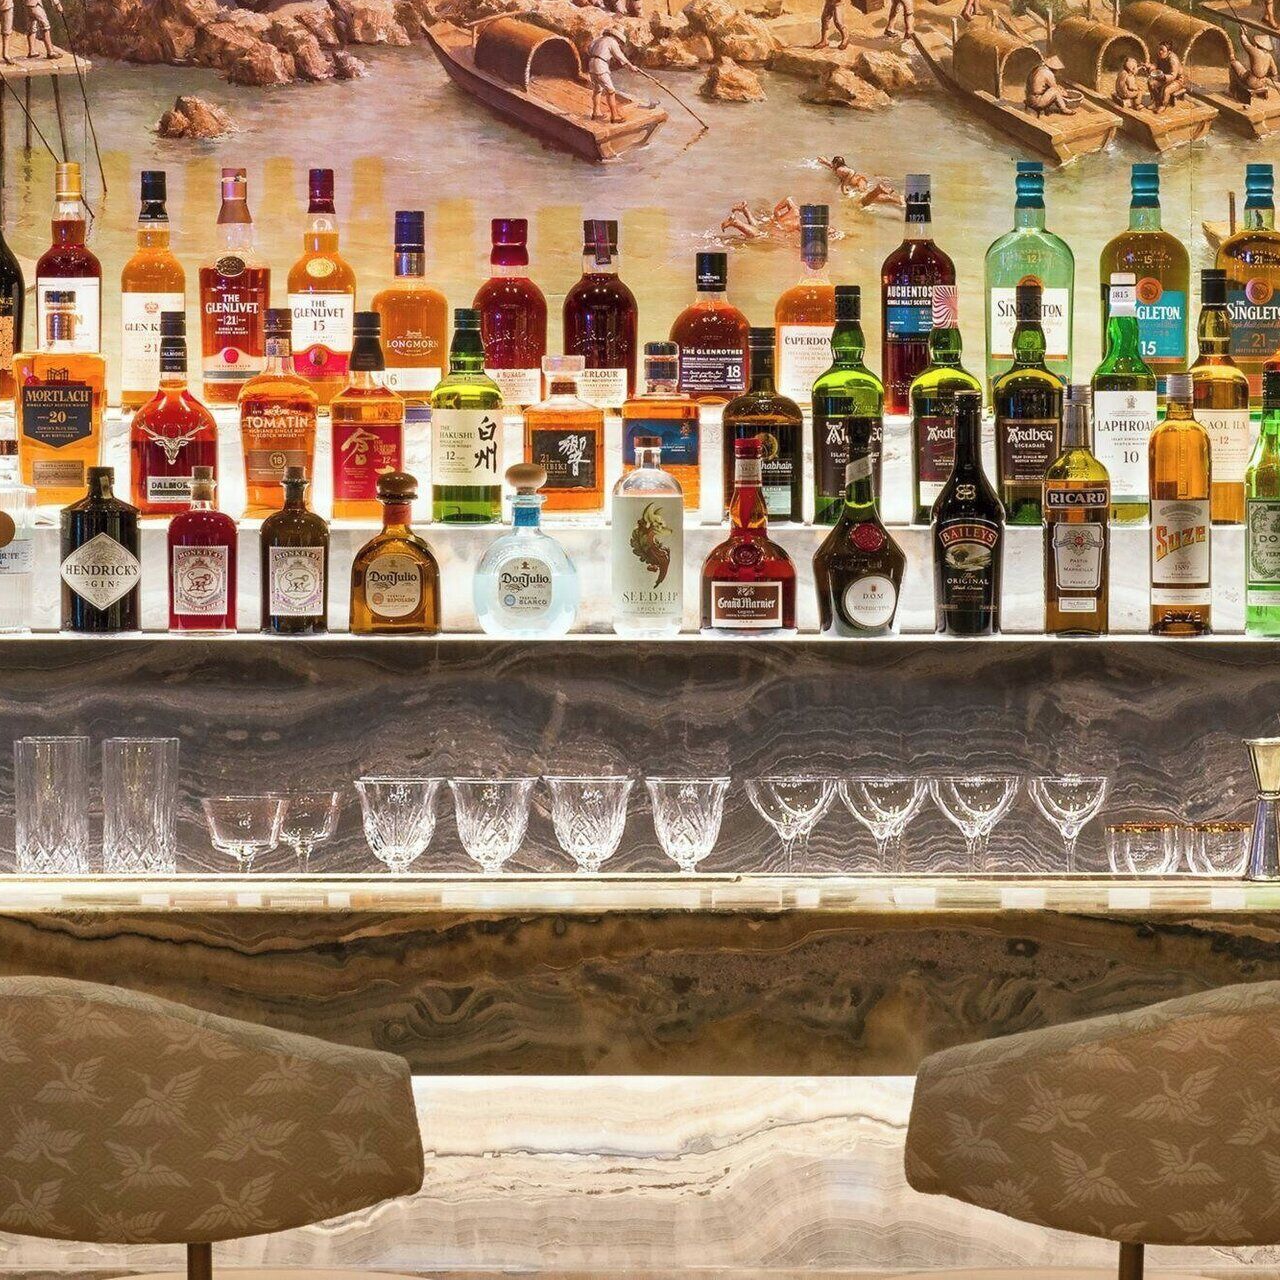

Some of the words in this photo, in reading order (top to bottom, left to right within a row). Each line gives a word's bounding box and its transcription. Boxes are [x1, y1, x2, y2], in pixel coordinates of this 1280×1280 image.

[887, 286, 932, 297] AUCHENTOS
[222, 294, 239, 302] THE
[205, 303, 258, 314] GLENLIVET
[294, 308, 344, 318] GLENLIVET
[997, 301, 1062, 318] SINTON
[1137, 306, 1180, 320] GLETON
[226, 316, 236, 325] 21
[313, 320, 325, 331] 15
[125, 323, 150, 332] GLEN
[386, 340, 439, 348] LONGMORN
[1251, 333, 1265, 347] 21
[1141, 341, 1156, 356] 15
[581, 370, 618, 378] ERLOUR
[727, 366, 741, 377] 18
[25, 390, 89, 402] MORTLACH
[49, 411, 67, 423] 20
[246, 416, 308, 428] TOMATIN
[474, 416, 497, 473] 白州
[1219, 436, 1229, 445] 12
[446, 451, 455, 460] 12
[1124, 451, 1139, 463] 10
[152, 481, 191, 490] DALMOR
[1050, 492, 1105, 504] RICARD
[942, 527, 996, 543] BAILEYS
[1156, 525, 1206, 562] Suze
[66, 565, 137, 576] HENDRICK'S
[370, 571, 389, 582] Don
[390, 571, 417, 586] Julio
[501, 573, 521, 584] Don
[623, 591, 679, 603] SEEDLIP
[718, 597, 741, 609] Grand
[742, 597, 775, 609] Marnier
